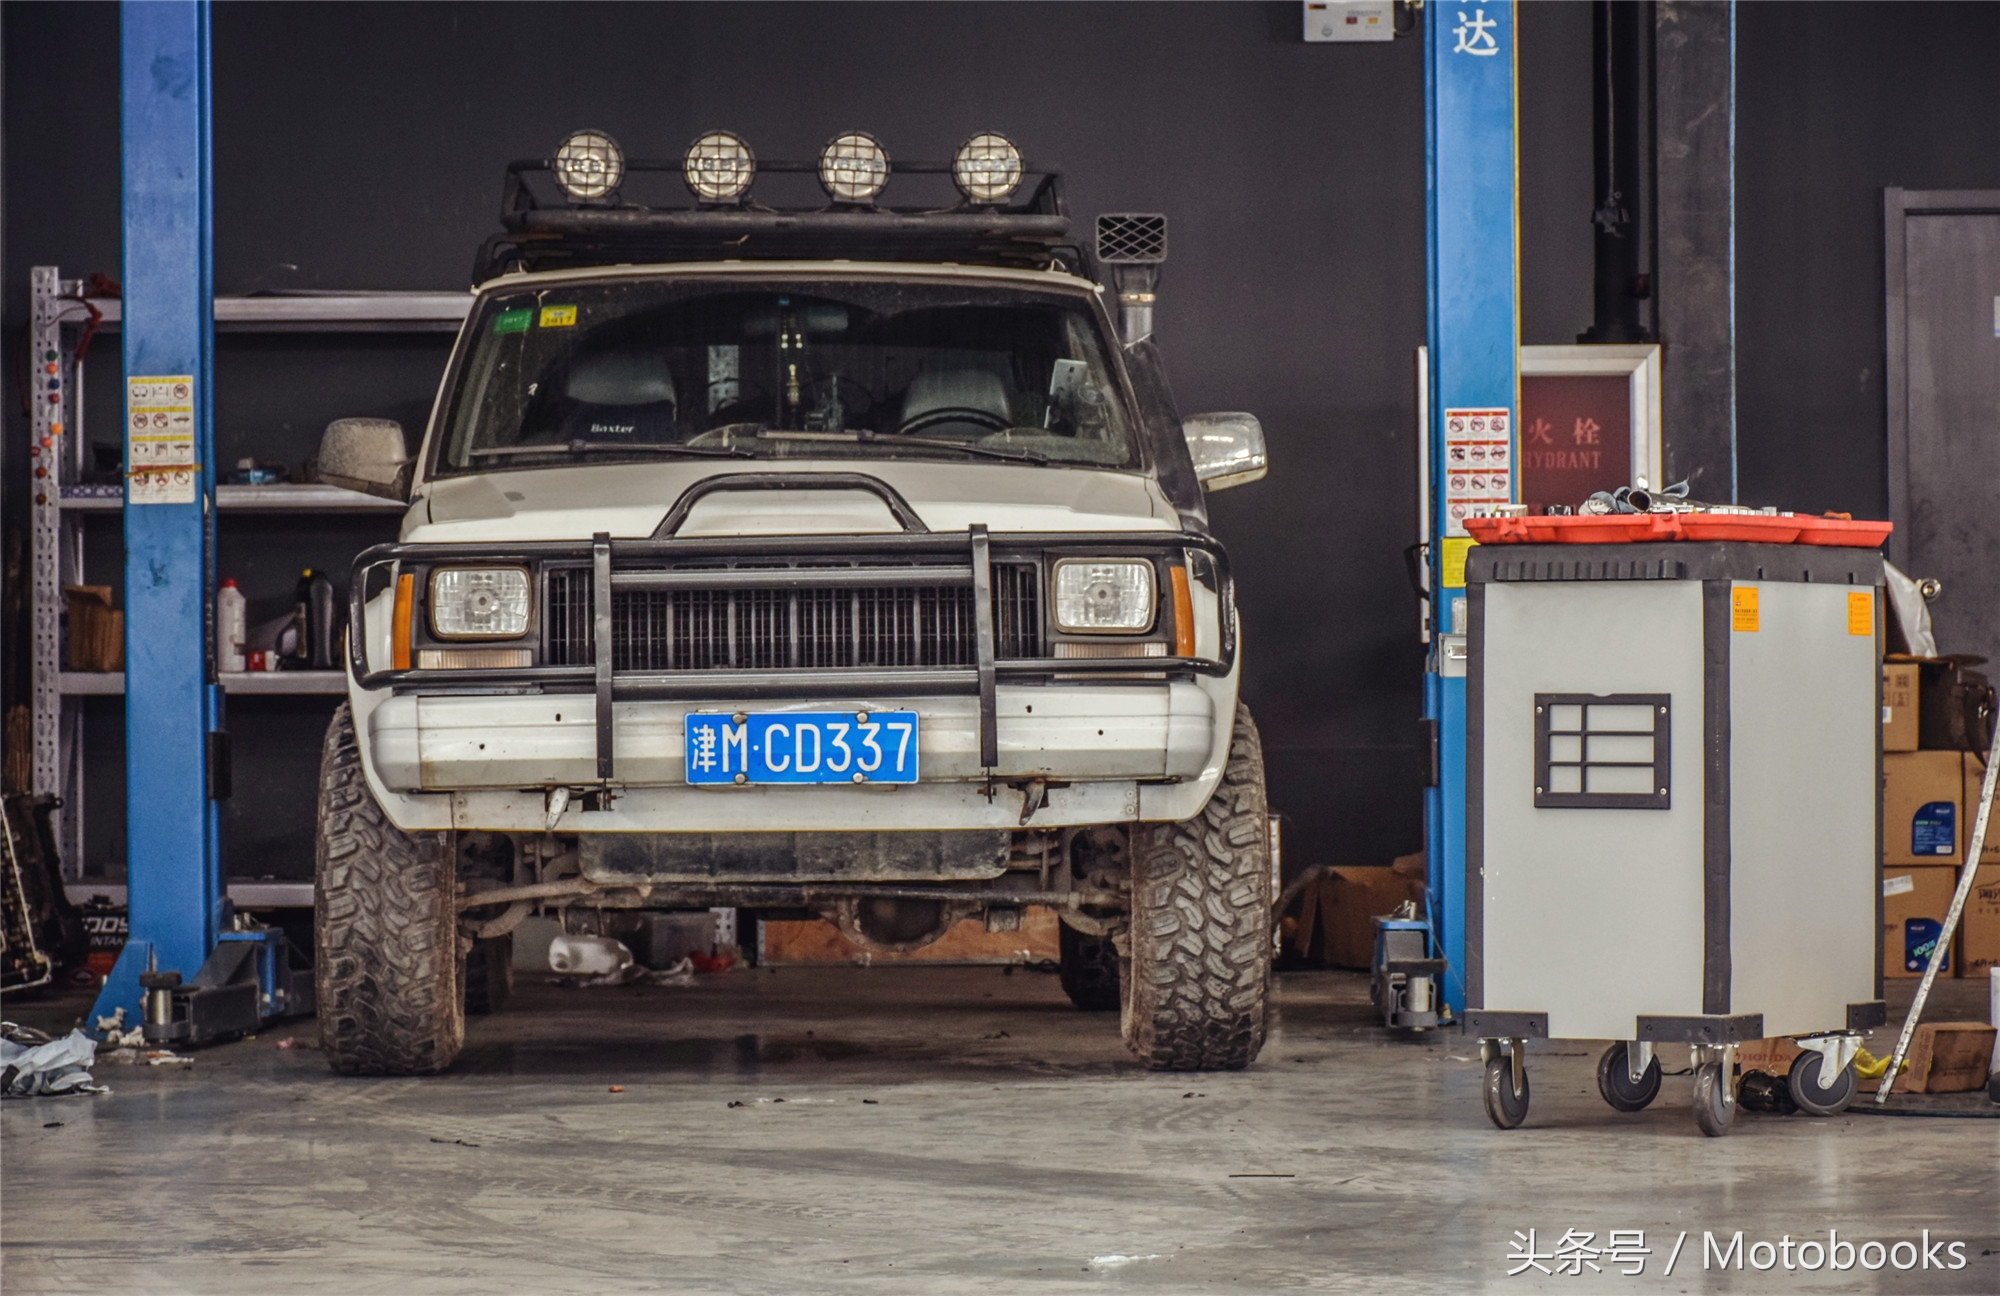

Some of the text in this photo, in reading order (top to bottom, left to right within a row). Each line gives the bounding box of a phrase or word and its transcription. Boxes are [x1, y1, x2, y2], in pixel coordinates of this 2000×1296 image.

[1452, 0, 1500, 56] 达
[591, 424, 634, 434] Baxter
[1523, 451, 1600, 469] HYDRANT
[692, 723, 912, 773] 津M·CD337
[1743, 1051, 1794, 1062] HONDA
